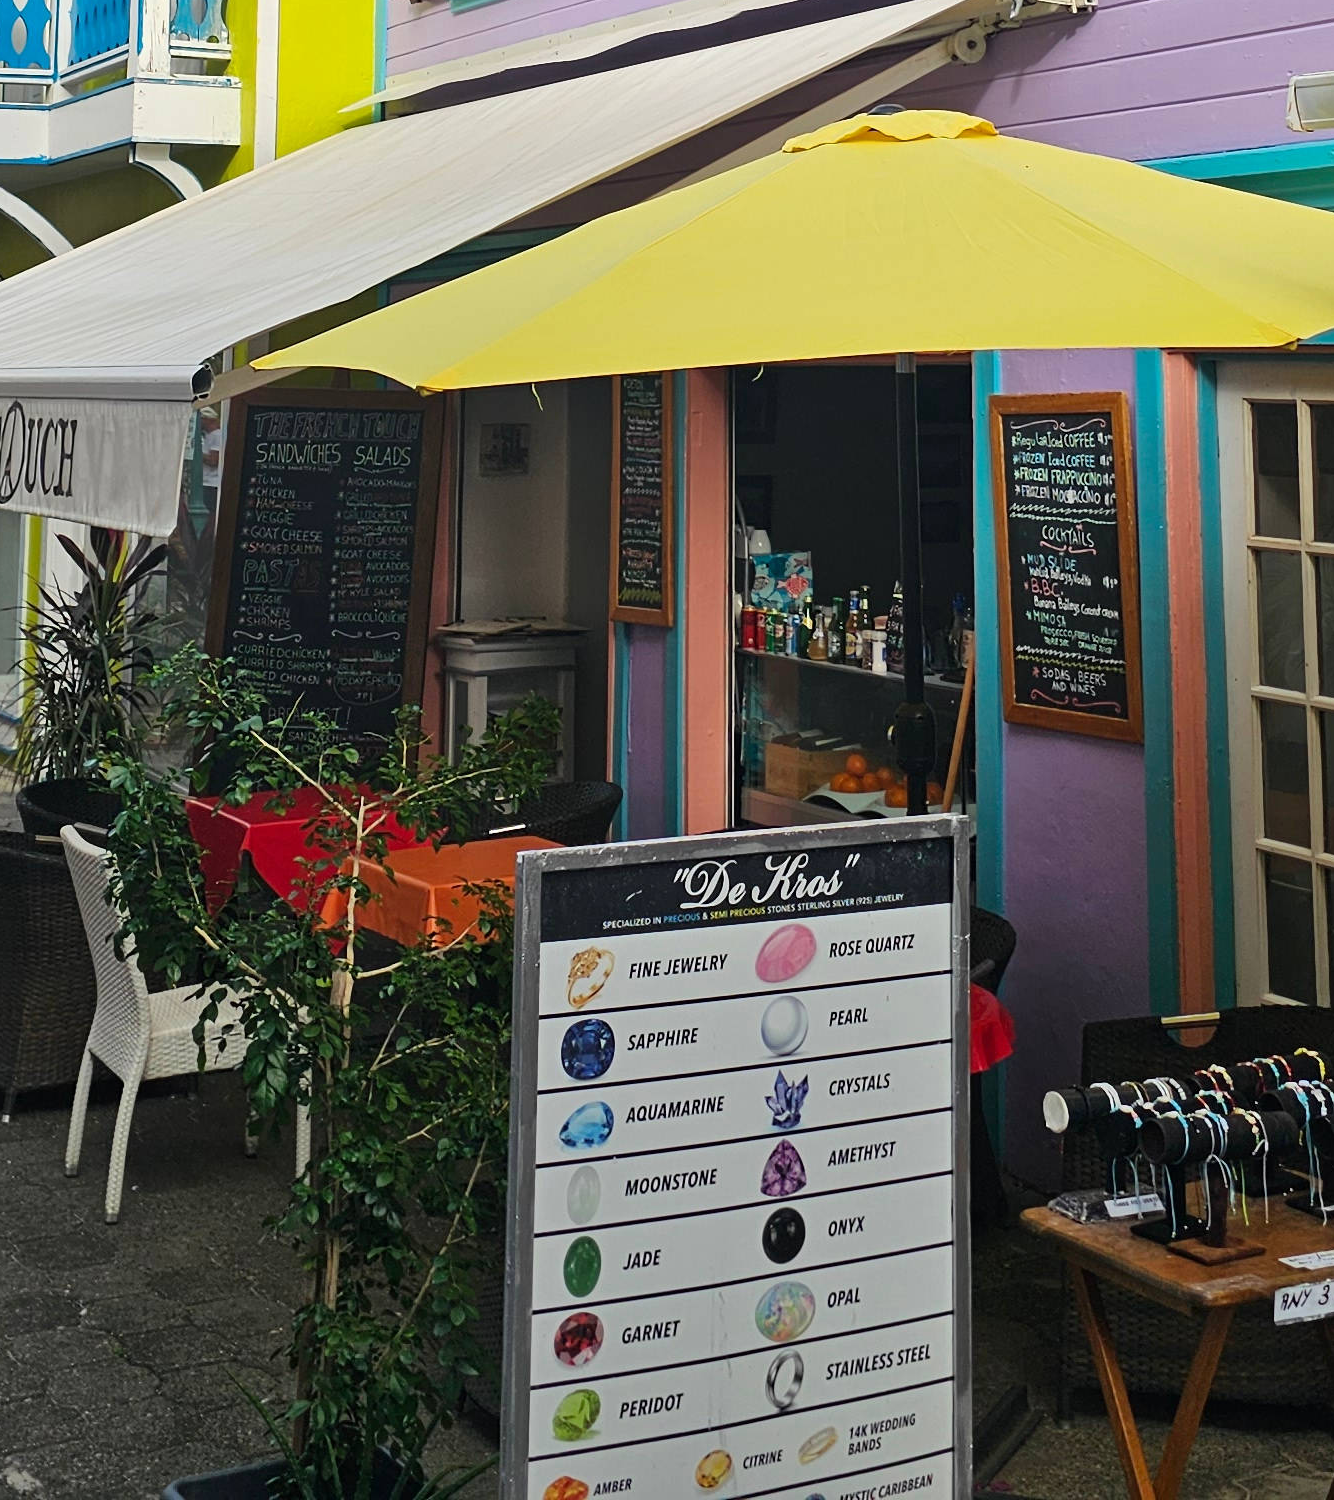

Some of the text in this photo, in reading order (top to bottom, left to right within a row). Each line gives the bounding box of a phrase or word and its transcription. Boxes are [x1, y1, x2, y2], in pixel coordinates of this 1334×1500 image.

[254, 411, 422, 440] THE FRENCH TOUCH
[1064, 432, 1095, 448] COFFEE
[353, 446, 411, 466] SALADS
[1019, 452, 1045, 464] FROZEN
[1066, 454, 1095, 468] COFFEE
[257, 475, 283, 484] TUNA
[1020, 467, 1048, 481] FROZEN
[1051, 469, 1102, 486] FRAPPUCCINO
[256, 487, 296, 499] CHICKEN
[1021, 485, 1050, 499] FROZEN
[250, 525, 323, 542] GOAT CHEESE
[1042, 525, 1094, 548] COCKTAILS
[248, 541, 290, 554] SMOKED
[341, 550, 402, 559] GOAT CHEESE
[246, 605, 291, 619] CHICKEN
[1033, 610, 1066, 627] MIMOSA
[280, 672, 320, 685] CHICKEN
[1052, 681, 1096, 696] AND WINES
[1078, 671, 1107, 686] BEERS
[602, 893, 905, 930] SPECIALIZED IN PRECIOUS & SEMI PRECIOUS STONES STERLING SILVER (925) JEWELRY
[829, 934, 915, 958] ROSE QUARTZ
[629, 953, 728, 979] FINE JEWELRY
[828, 1007, 868, 1027] PEARL
[627, 1027, 699, 1051] SAPPHIRE
[828, 1073, 891, 1096] CRYSTALS
[626, 1095, 725, 1124] AQUAMARINE
[827, 1141, 897, 1167] AMETHYST
[625, 1168, 717, 1197] MOONSTONE
[828, 1215, 865, 1238] ONYX
[622, 1249, 661, 1271] JADE
[827, 1287, 861, 1308] OPAL
[1280, 1288, 1312, 1311] ANY
[1318, 1284, 1330, 1305] 3
[621, 1320, 680, 1345] GARNET
[826, 1344, 932, 1380] STAINLESS STEEL
[619, 1392, 684, 1420] PERIDOT
[848, 1413, 916, 1441] 14K WEDDING
[847, 1437, 882, 1456] BANDS
[742, 1449, 783, 1470] CITRINE
[593, 1477, 632, 1496] AMBER
[878, 1473, 934, 1499] CARIBBEAN
